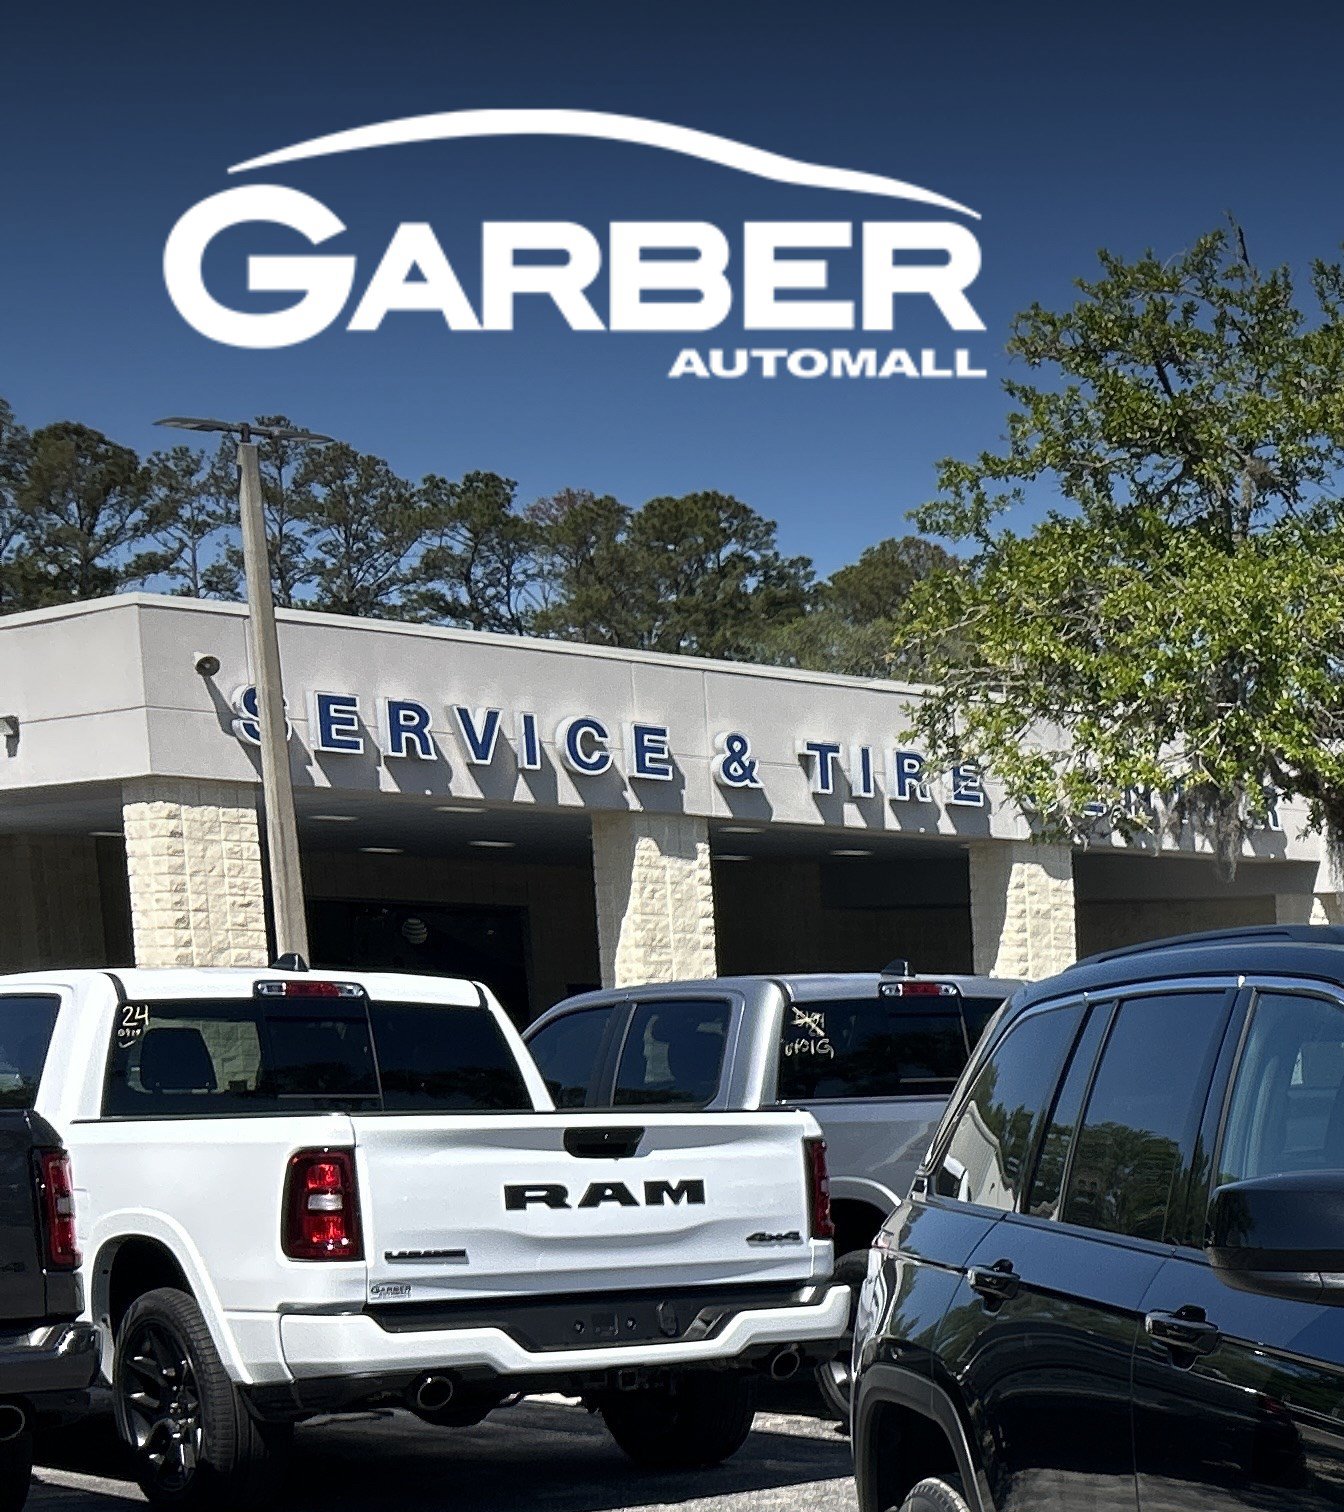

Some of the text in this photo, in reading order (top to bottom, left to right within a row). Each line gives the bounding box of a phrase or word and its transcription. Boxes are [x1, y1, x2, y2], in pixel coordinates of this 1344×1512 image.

[719, 731, 762, 789] &
[804, 740, 985, 807] TIRE
[122, 1004, 149, 1027] 24
[504, 1179, 706, 1211] RAM
